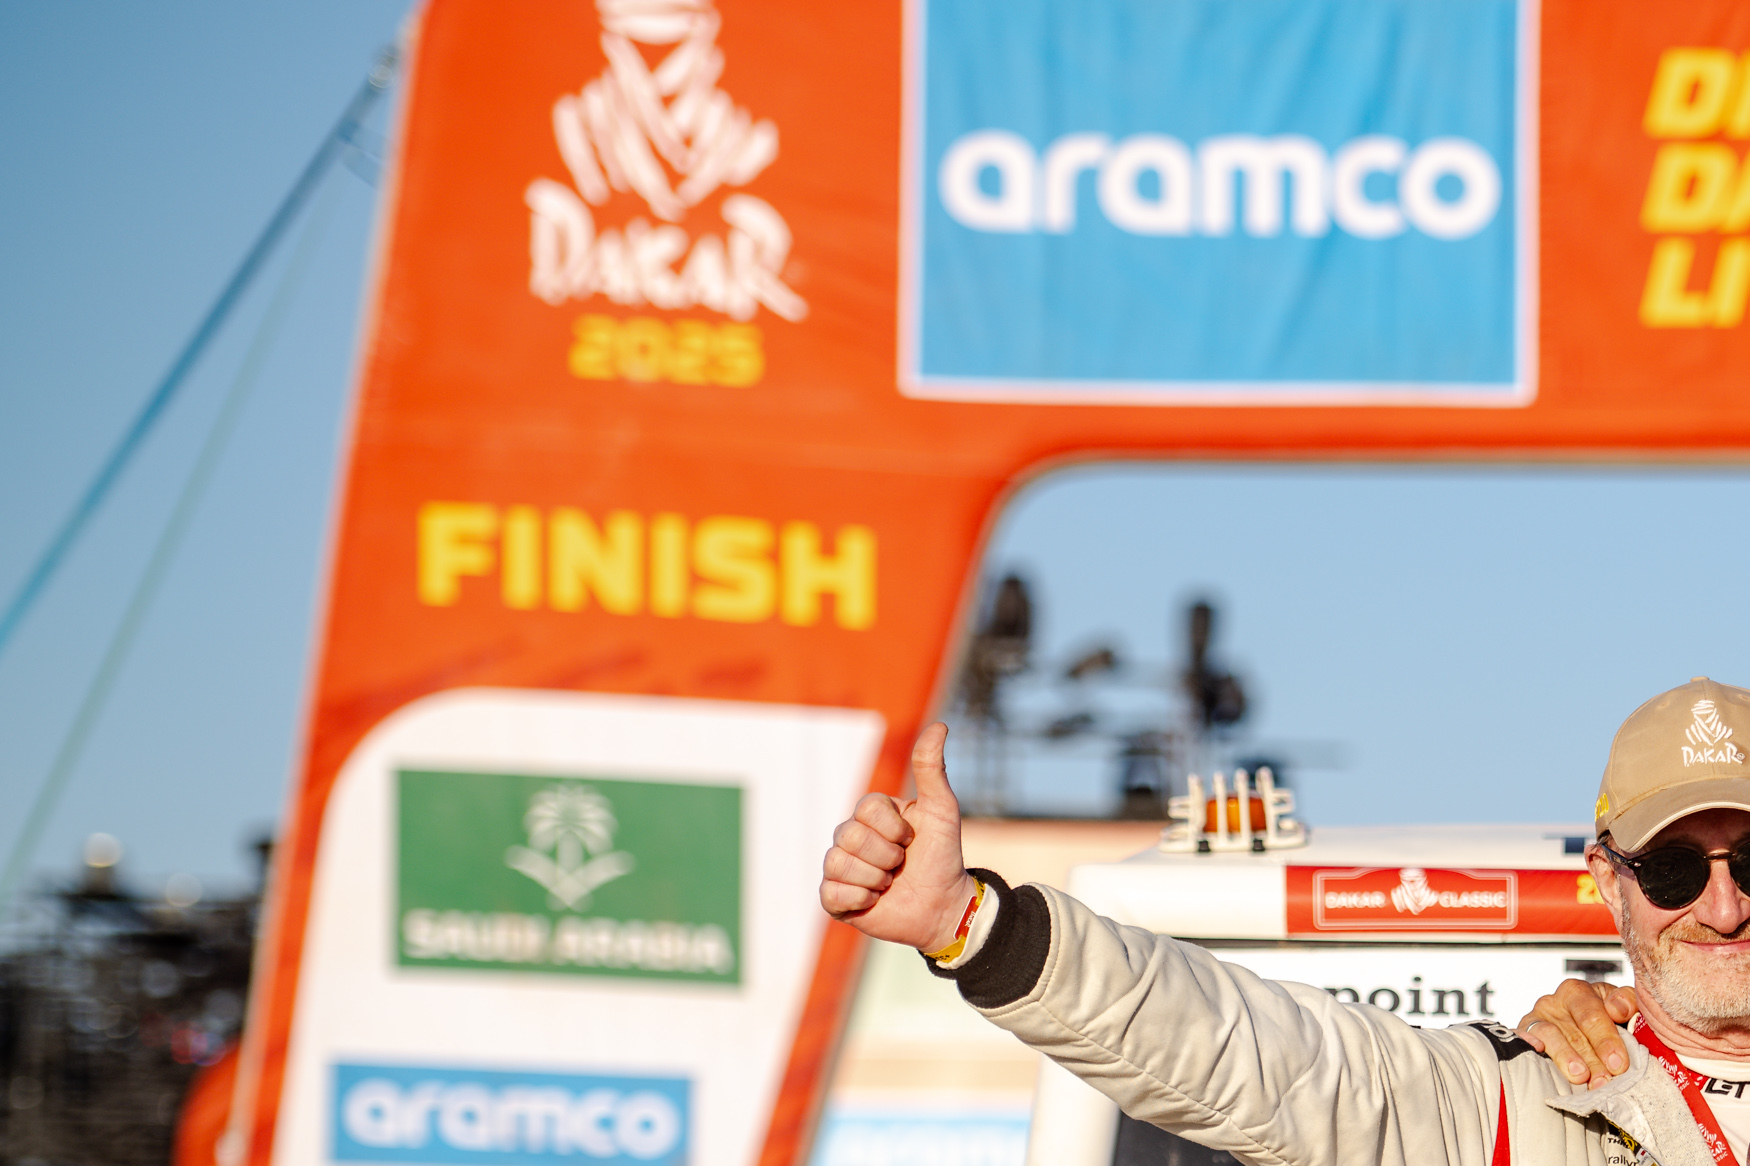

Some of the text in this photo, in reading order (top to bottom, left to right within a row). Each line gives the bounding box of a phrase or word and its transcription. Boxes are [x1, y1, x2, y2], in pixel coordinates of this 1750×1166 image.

[938, 130, 1502, 240] aramco
[526, 180, 808, 321] DAKAR
[569, 314, 766, 387] 2025
[417, 502, 877, 629] FINISH
[1681, 742, 1742, 767] DAKAR
[1325, 890, 1507, 909] DAKAR CLASSIC
[401, 908, 735, 973] SAUDI ARABIA
[343, 1079, 680, 1158] aramco
